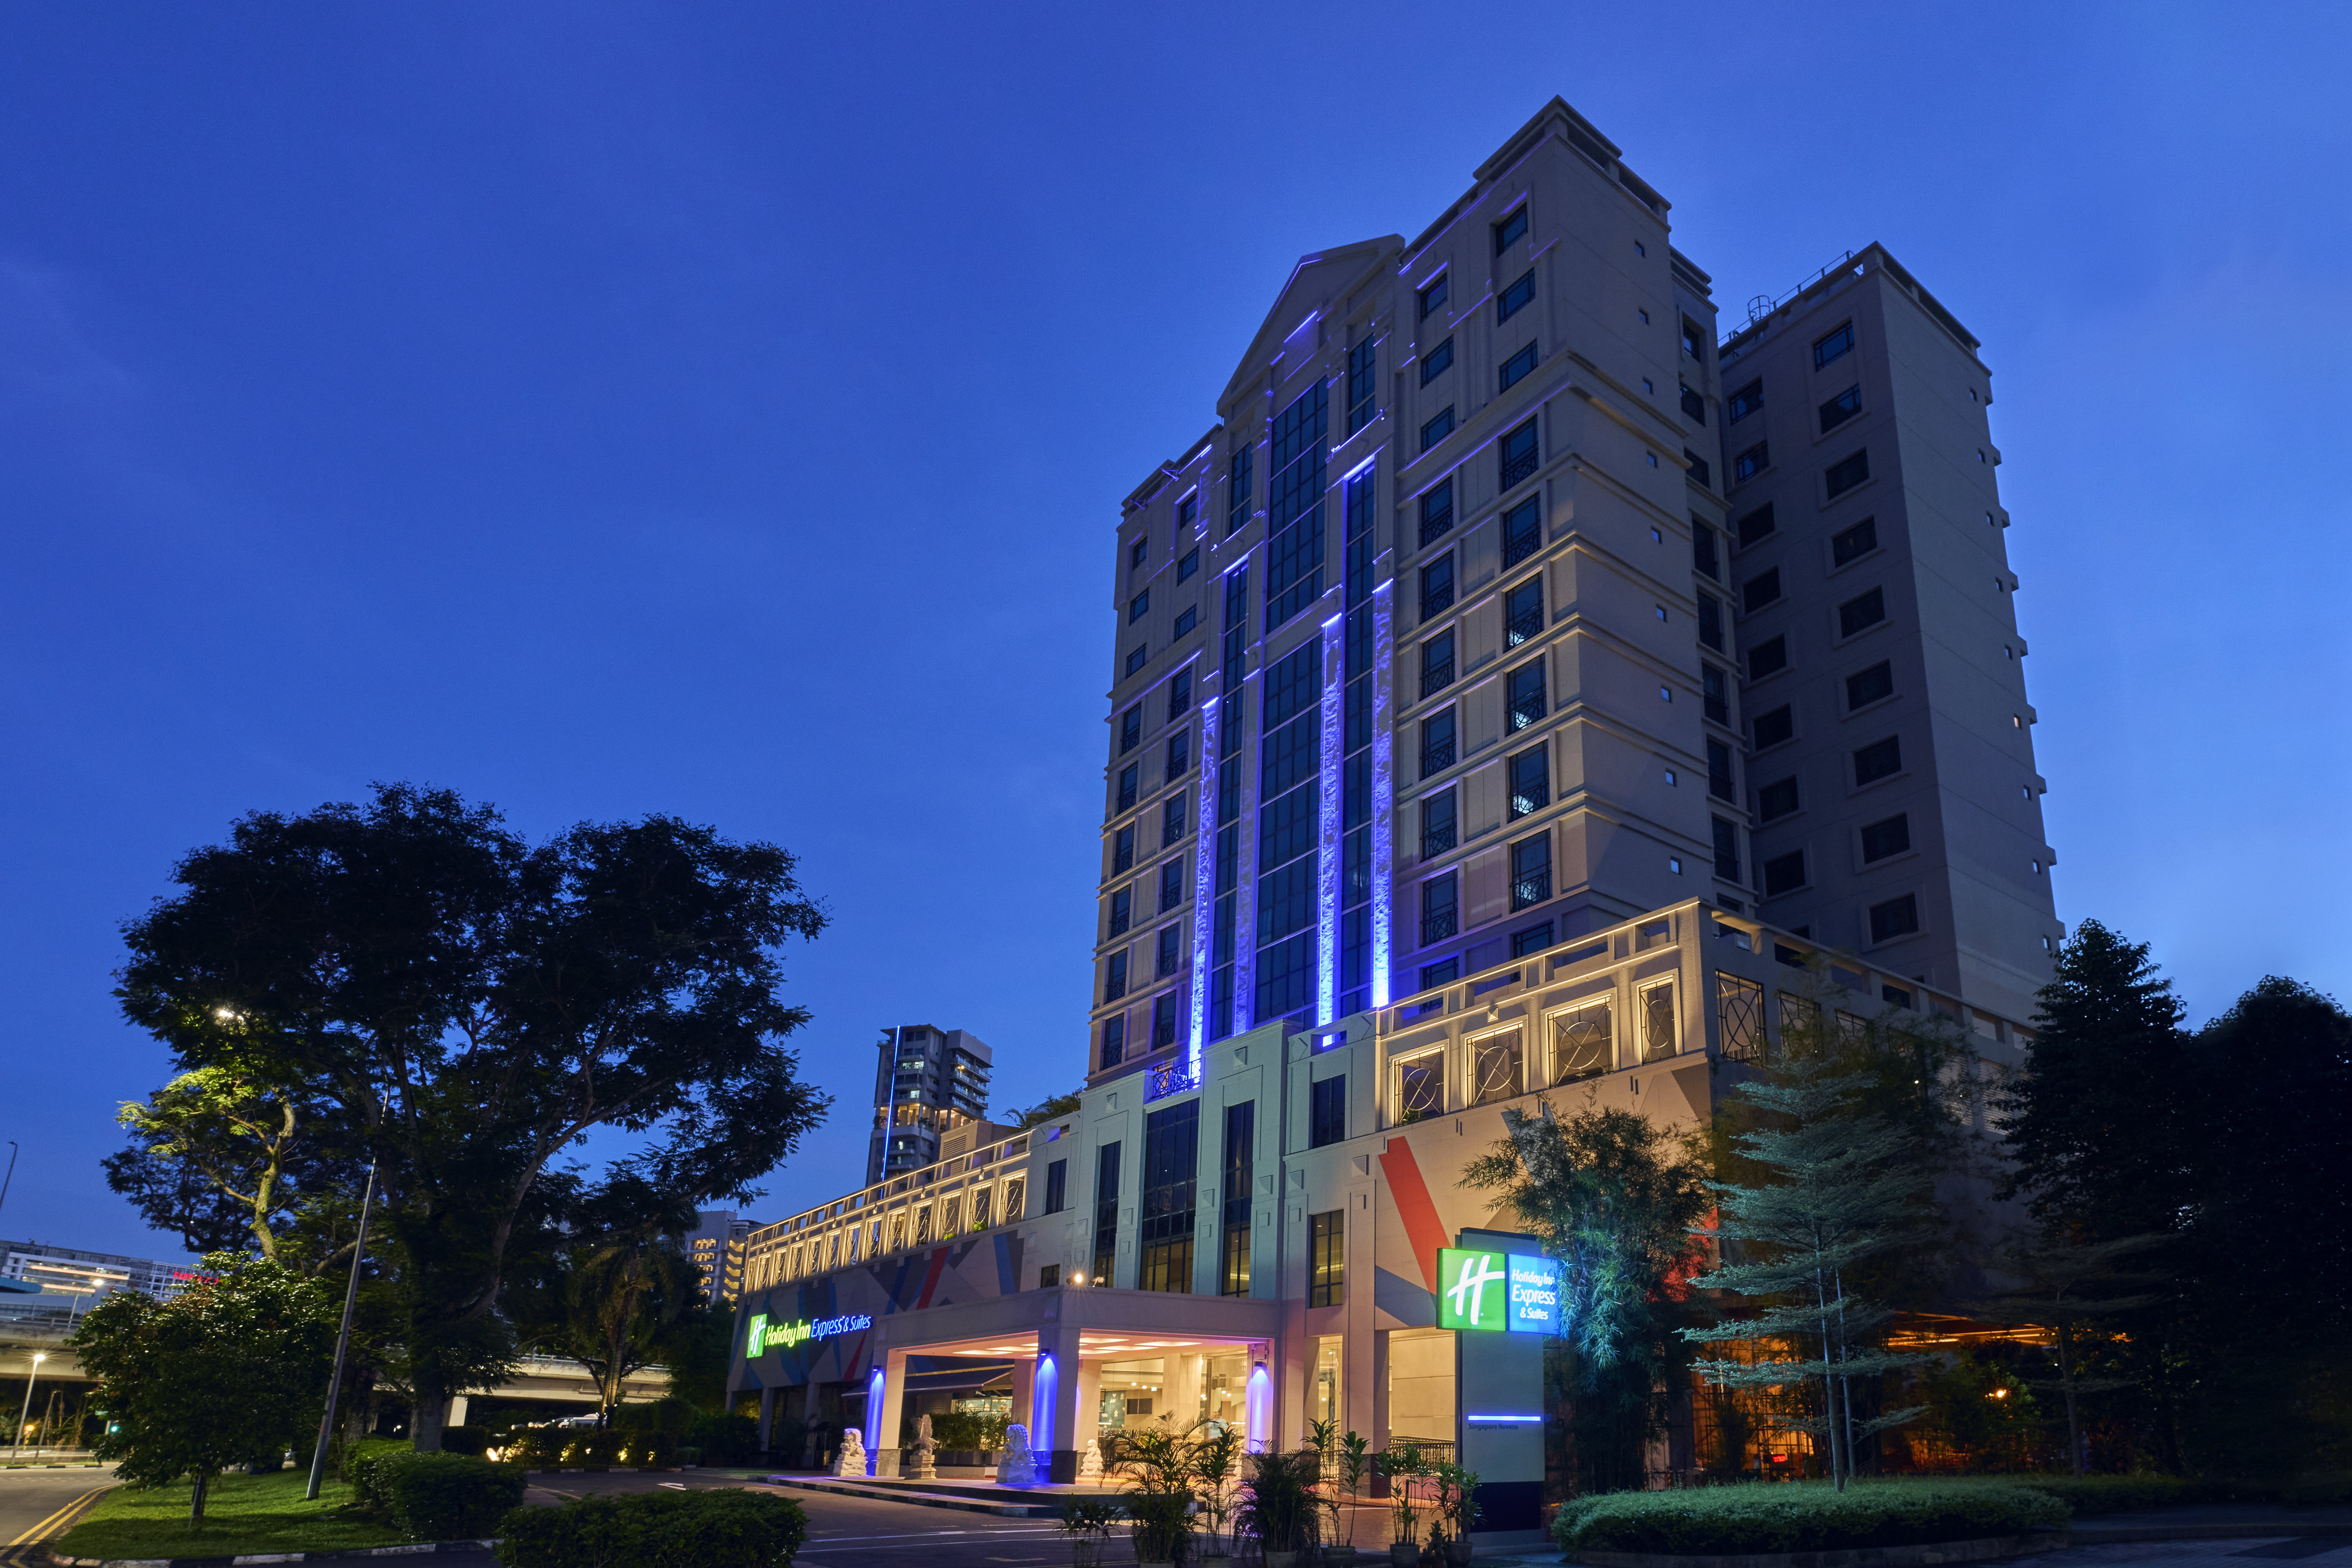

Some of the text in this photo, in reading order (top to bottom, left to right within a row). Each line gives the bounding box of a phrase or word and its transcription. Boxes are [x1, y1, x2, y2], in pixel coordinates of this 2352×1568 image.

[1511, 1269, 1543, 1287] Holiday
[1512, 1284, 1556, 1307] Express
[1520, 1307, 1548, 1320] & Suites
[765, 1315, 871, 1347] Holiday Inn Express & Suites
[1468, 1423, 1497, 1431] Singapore
